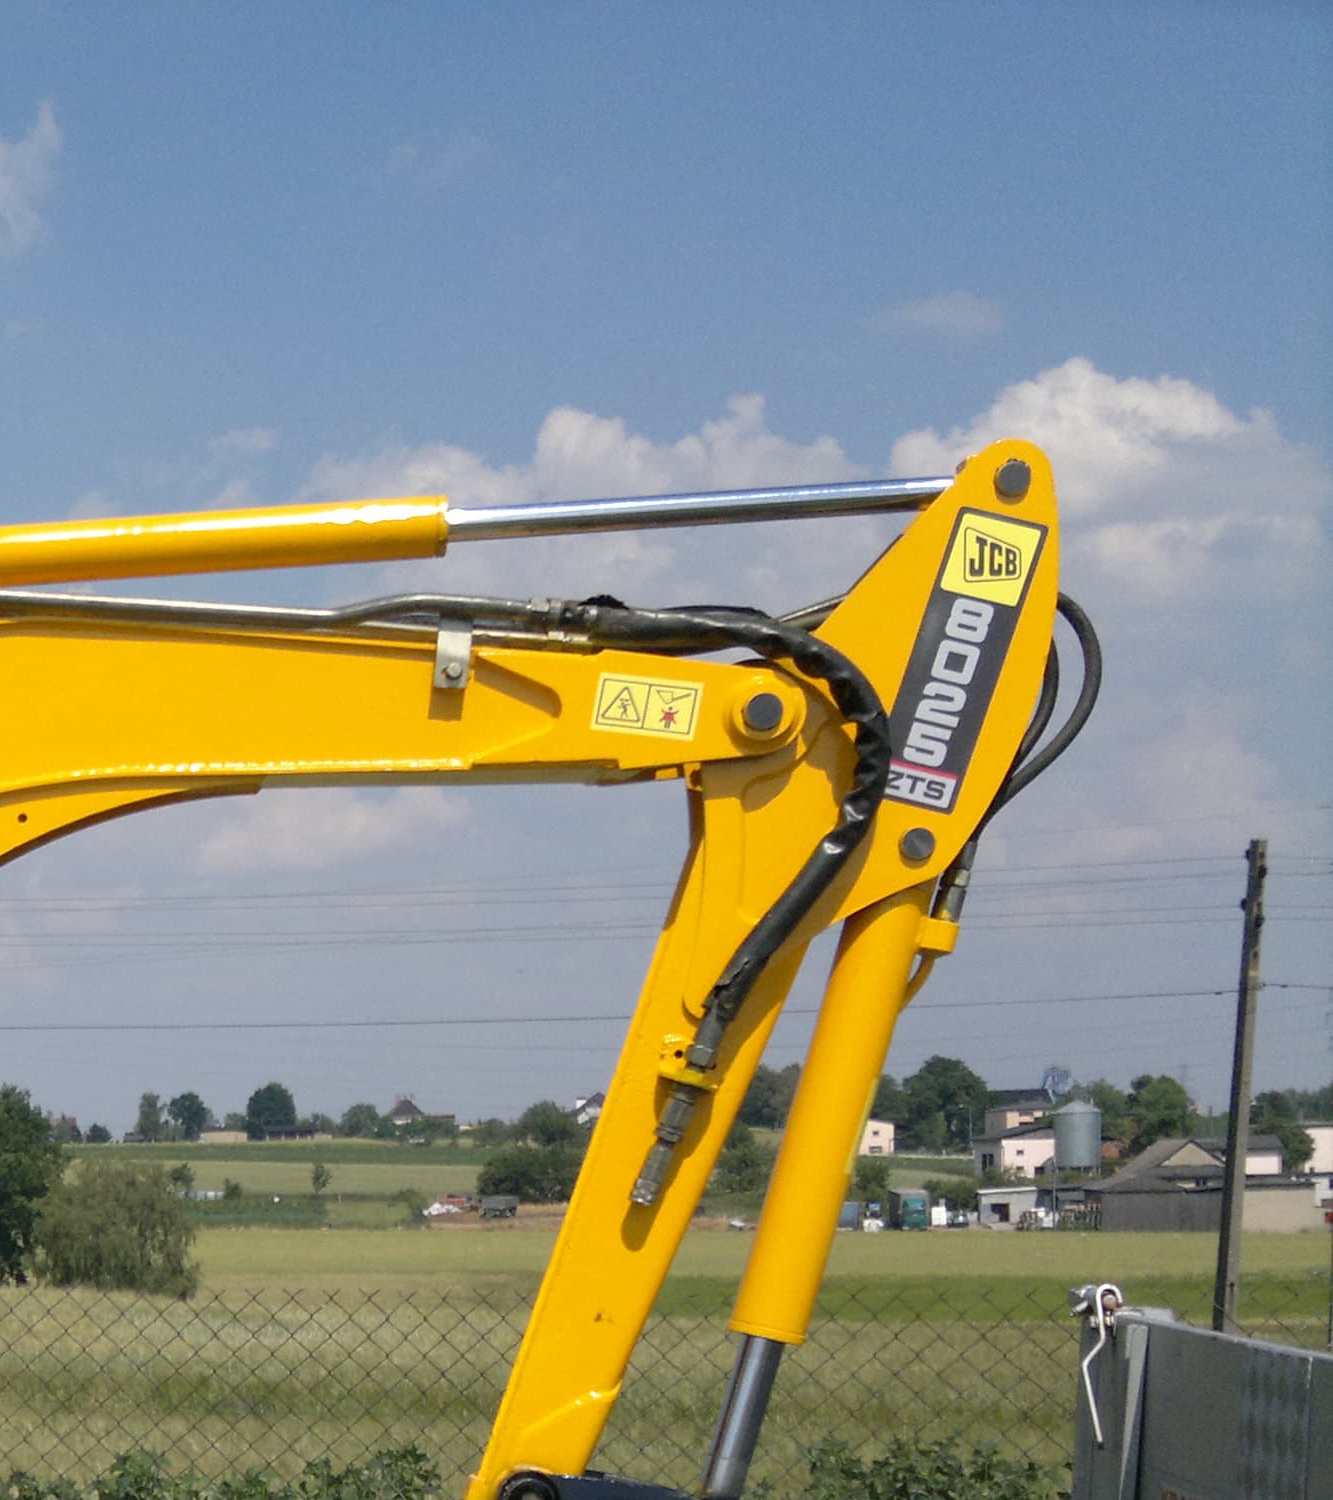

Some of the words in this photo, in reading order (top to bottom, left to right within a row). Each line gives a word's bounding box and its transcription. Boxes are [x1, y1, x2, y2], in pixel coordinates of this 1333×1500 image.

[968, 536, 1018, 577] JCB
[903, 598, 994, 768] 8025
[887, 770, 946, 800] ZTS
